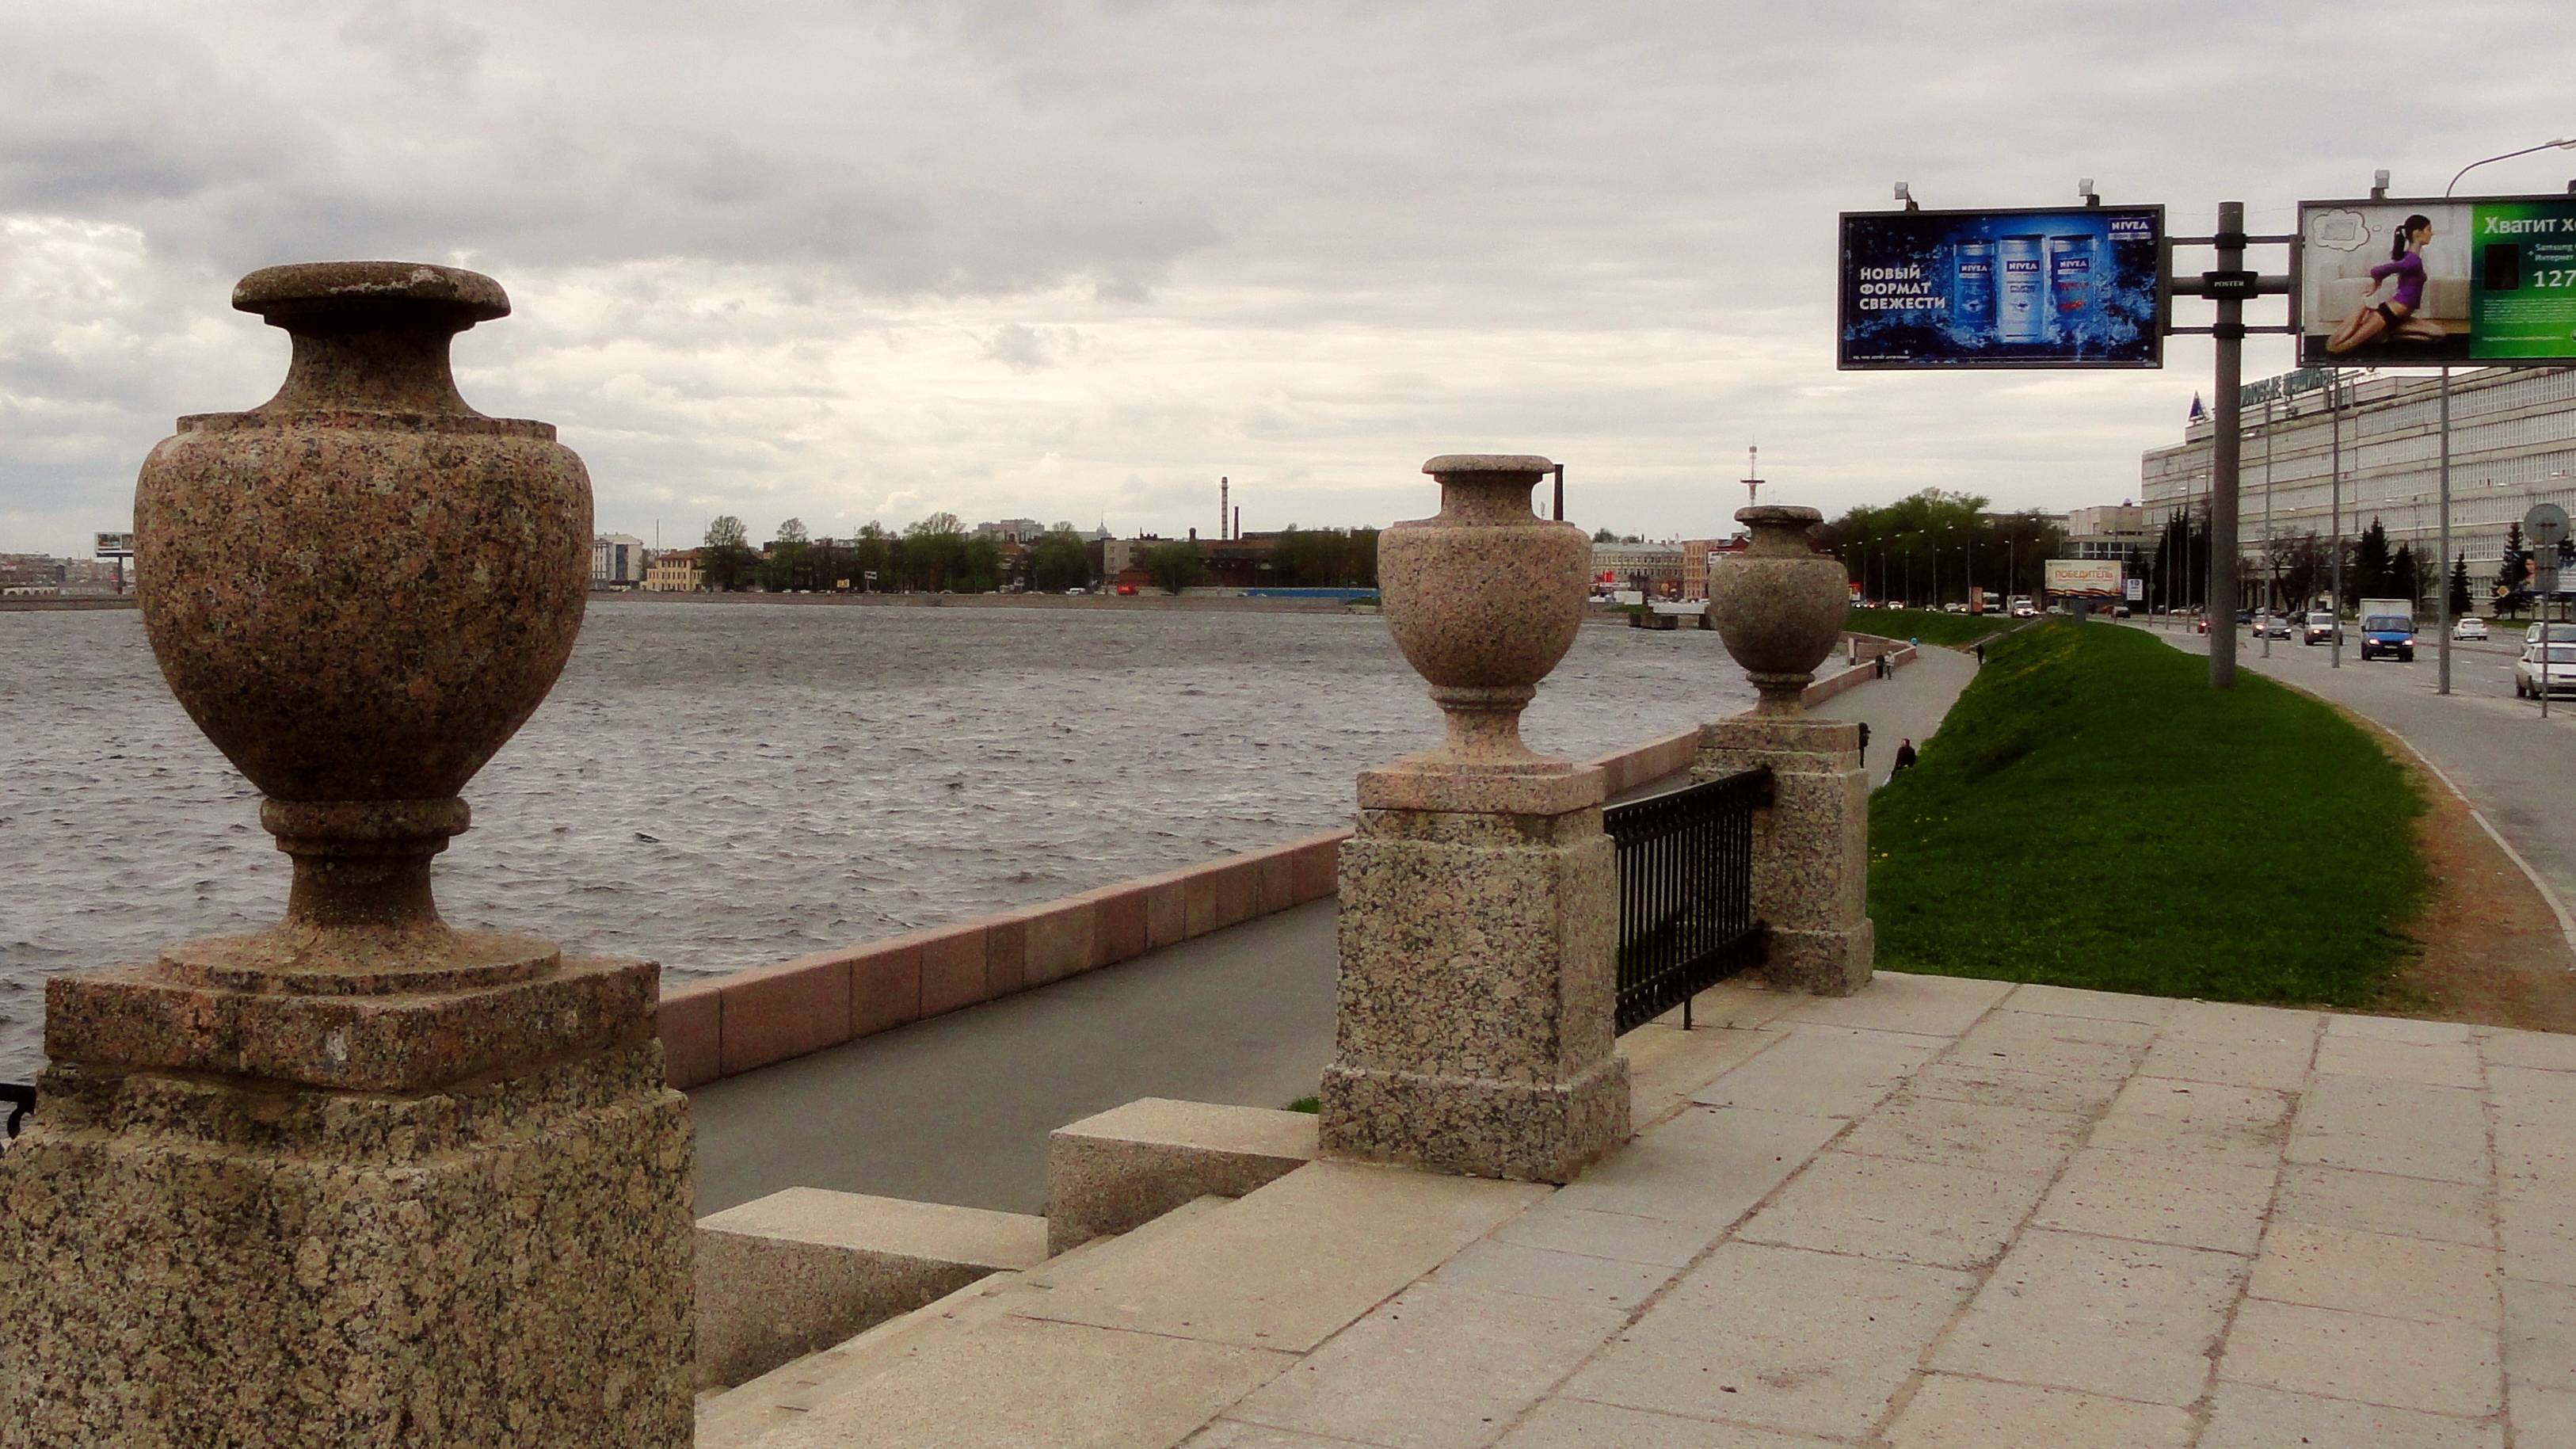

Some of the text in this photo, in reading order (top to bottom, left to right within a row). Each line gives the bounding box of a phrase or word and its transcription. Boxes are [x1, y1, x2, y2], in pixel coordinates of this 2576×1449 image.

[2111, 221, 2149, 231] NIVEA
[2483, 216, 2558, 235] Хватит
[1859, 262, 1921, 280] НОВЫЙ
[1859, 282, 1932, 296] ФОРМАТ
[1859, 297, 1945, 310] СВЕЖЕСТИ
[2055, 570, 2113, 579] ПОБЕДИТЕЛЬ
